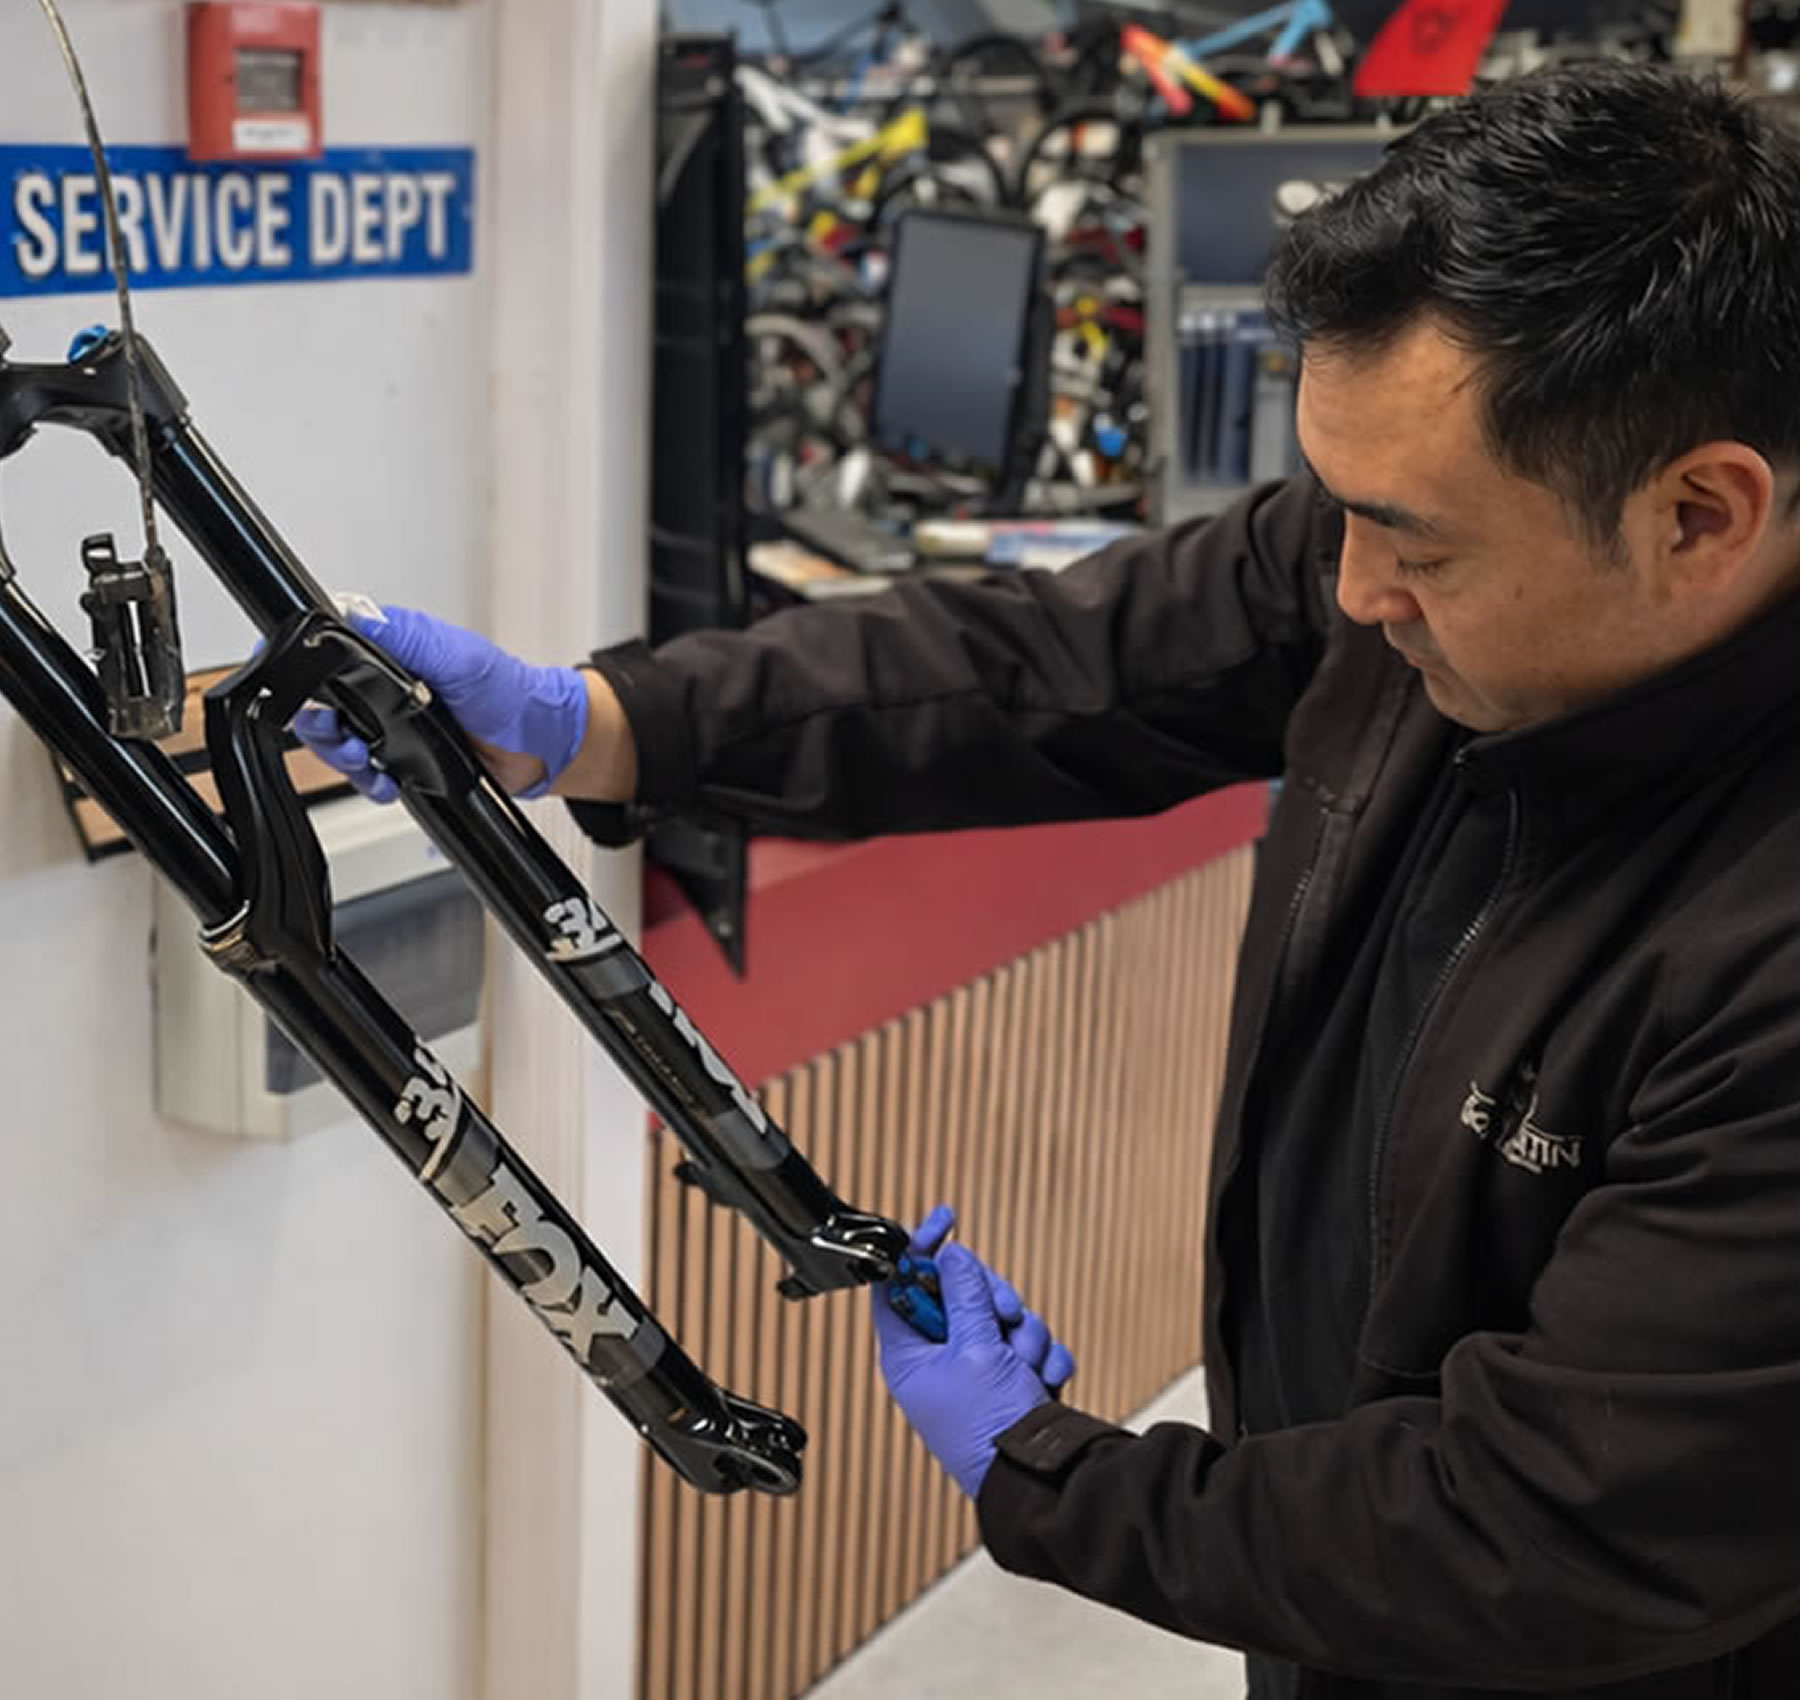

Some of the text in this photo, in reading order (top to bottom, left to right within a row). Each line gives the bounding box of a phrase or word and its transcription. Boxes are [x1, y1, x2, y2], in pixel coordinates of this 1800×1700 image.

[14, 173, 455, 277] SERVICE DEPT
[450, 1163, 639, 1363] FOX
